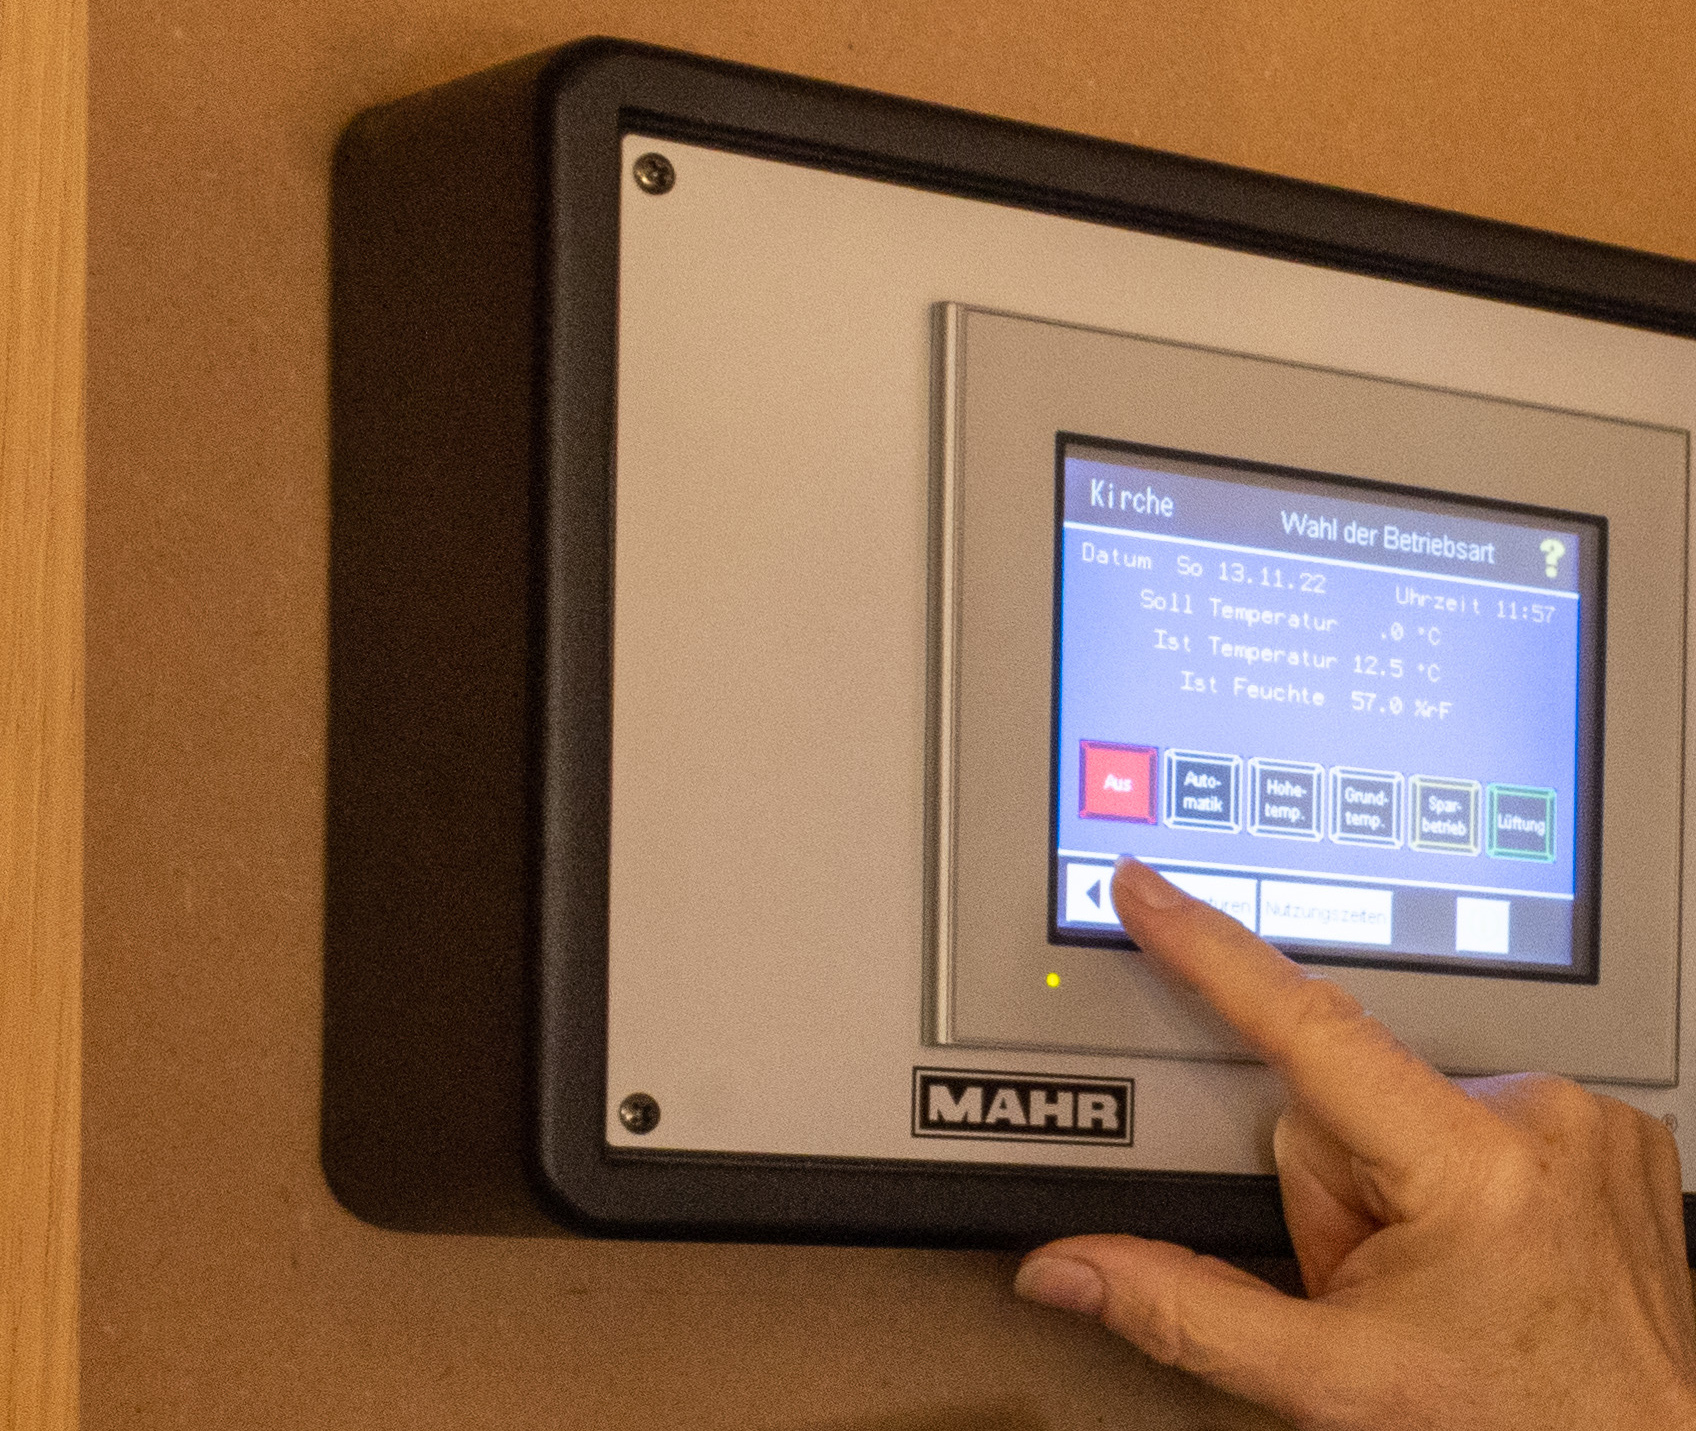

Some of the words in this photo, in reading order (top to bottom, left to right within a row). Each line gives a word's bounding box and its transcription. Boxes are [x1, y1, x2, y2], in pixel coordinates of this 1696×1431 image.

[1091, 478, 1174, 518] Kirche
[1281, 510, 1338, 541] Wahl
[1344, 521, 1378, 547] der
[1384, 525, 1496, 565] Betriebsart
[1082, 541, 1152, 570] Datum
[1177, 555, 1203, 577] So
[1219, 562, 1327, 594] 13.11.22
[1140, 589, 1194, 615] Soll
[1209, 597, 1339, 632] Temperatur
[1396, 586, 1481, 615] Uhrzeit
[1497, 600, 1556, 624] 11:57
[1154, 628, 1191, 653] Ist
[1208, 635, 1338, 670] Temperatur
[1354, 655, 1404, 678] 12.5
[1180, 670, 1218, 693] Ist
[1233, 676, 1326, 706] Feuchte
[1352, 691, 1403, 715] 57.0
[1103, 773, 1134, 793] Aus
[1184, 769, 1222, 789] Auto-
[1183, 796, 1224, 813] matik
[1344, 786, 1388, 806] Grund-
[1428, 795, 1462, 815] Spar-
[1265, 802, 1305, 823] temp.
[1345, 810, 1386, 831] temp.
[1498, 813, 1547, 837] Lüftung
[1422, 817, 1468, 837] betrieb
[1265, 900, 1387, 926] Nutzungszeiten
[928, 1083, 1121, 1131] MAHR
